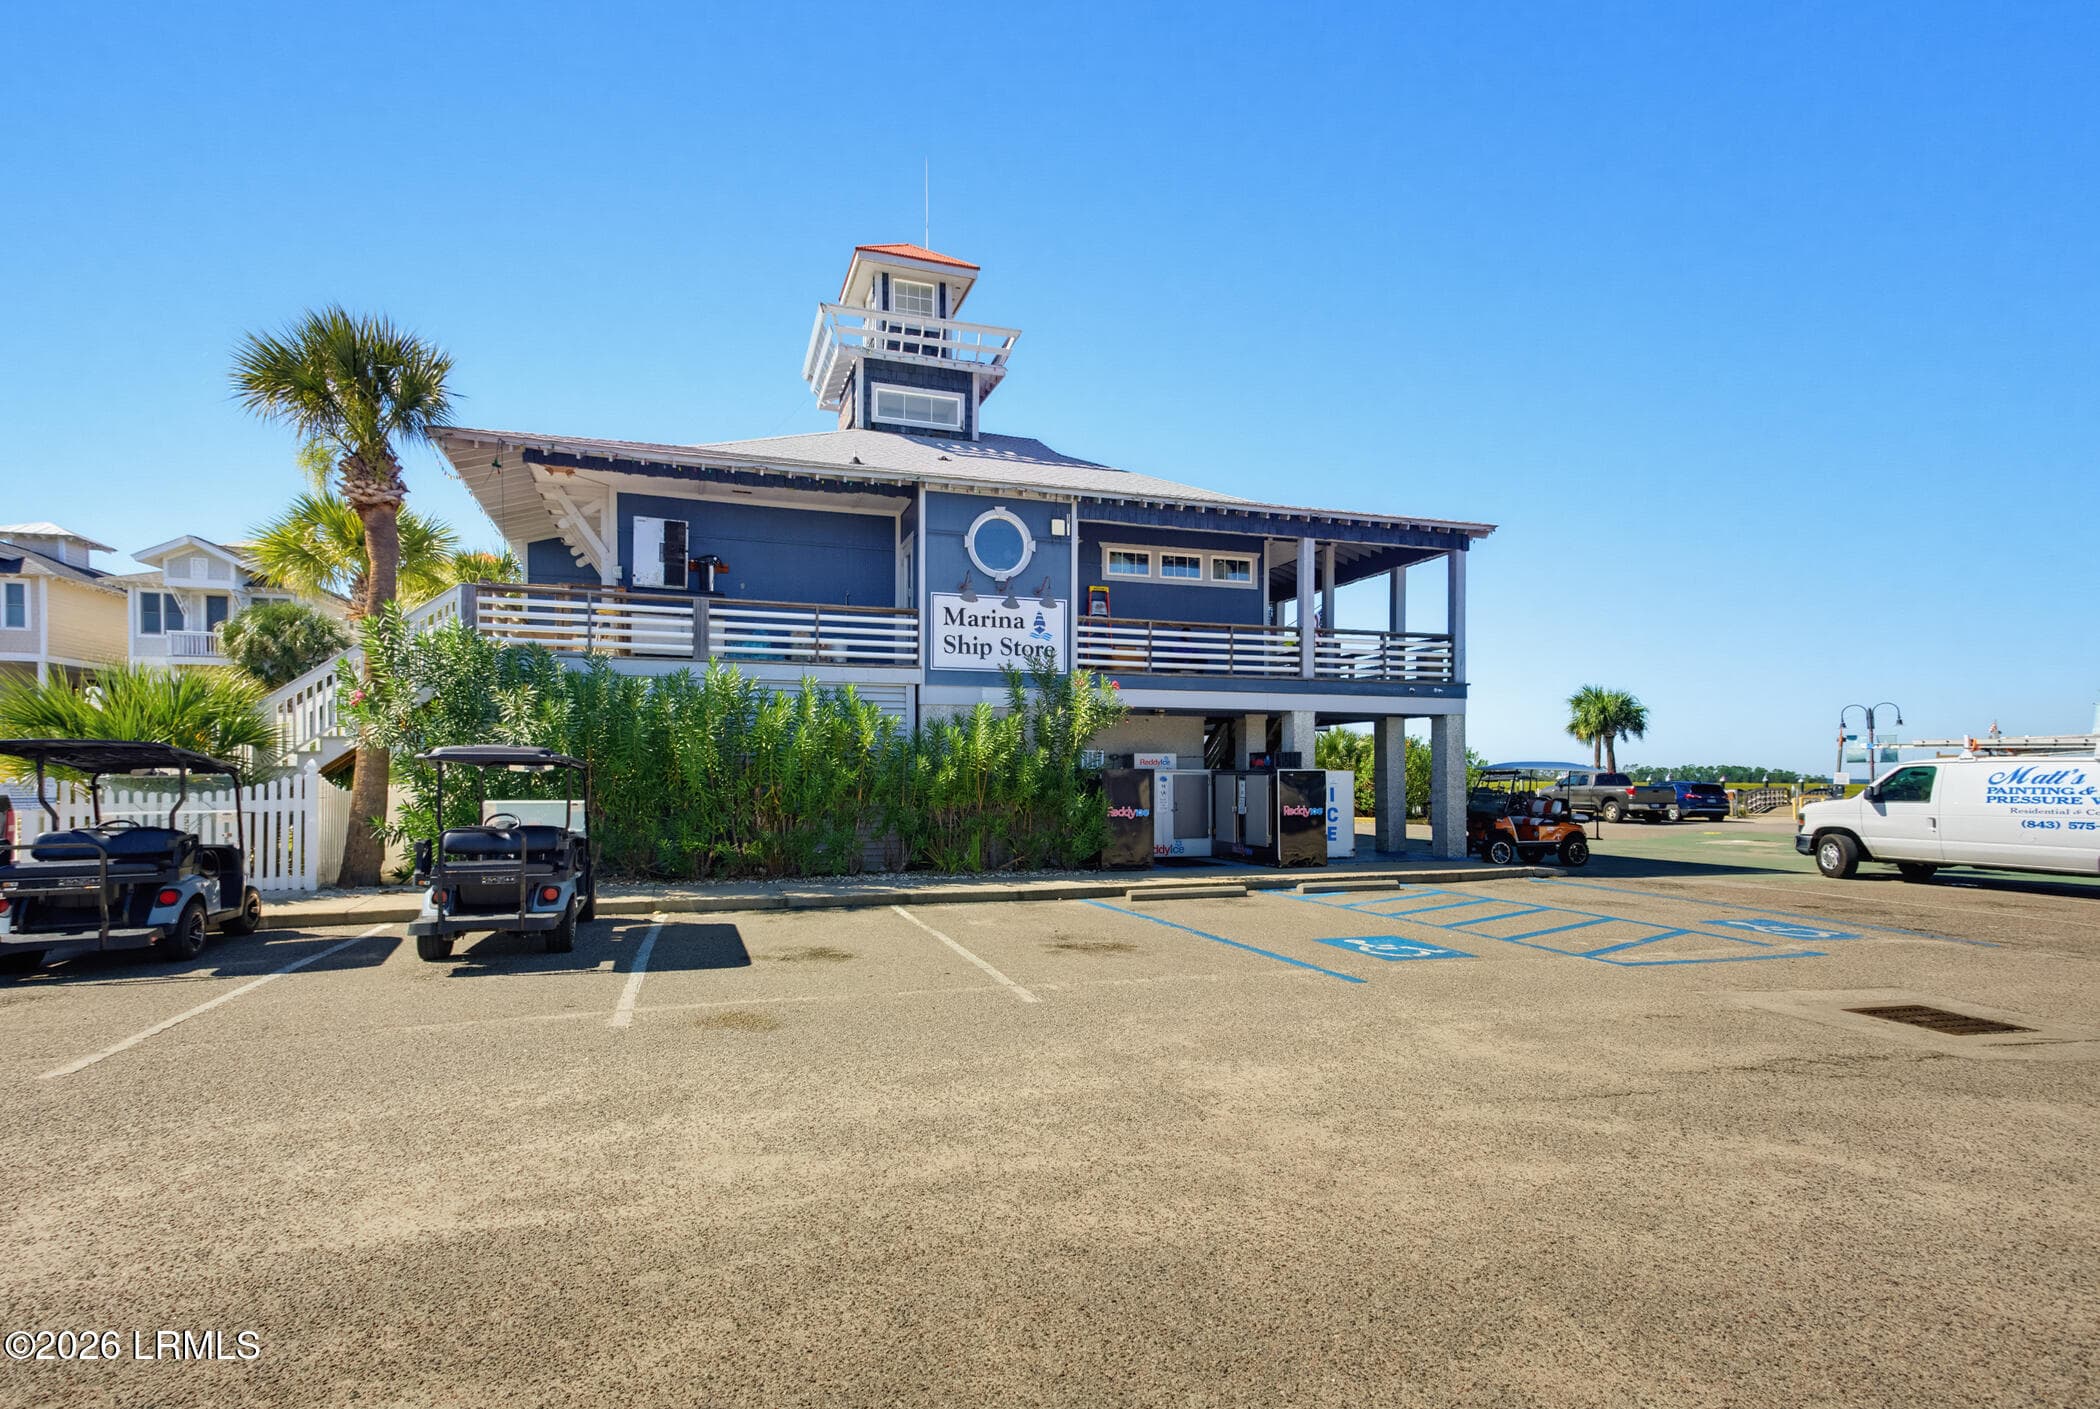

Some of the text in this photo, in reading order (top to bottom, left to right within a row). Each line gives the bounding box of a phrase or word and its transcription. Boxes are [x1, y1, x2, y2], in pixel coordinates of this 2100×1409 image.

[943, 606, 1026, 630] Marina
[943, 634, 1056, 660] Ship Store
[1988, 765, 2087, 785] Matt's
[1986, 786, 2098, 796] PAINTING &
[1985, 795, 2083, 805] PRESSURE
[1327, 786, 1339, 842] ICE
[2010, 807, 2070, 815] Residential
[2020, 819, 2061, 829] (843)
